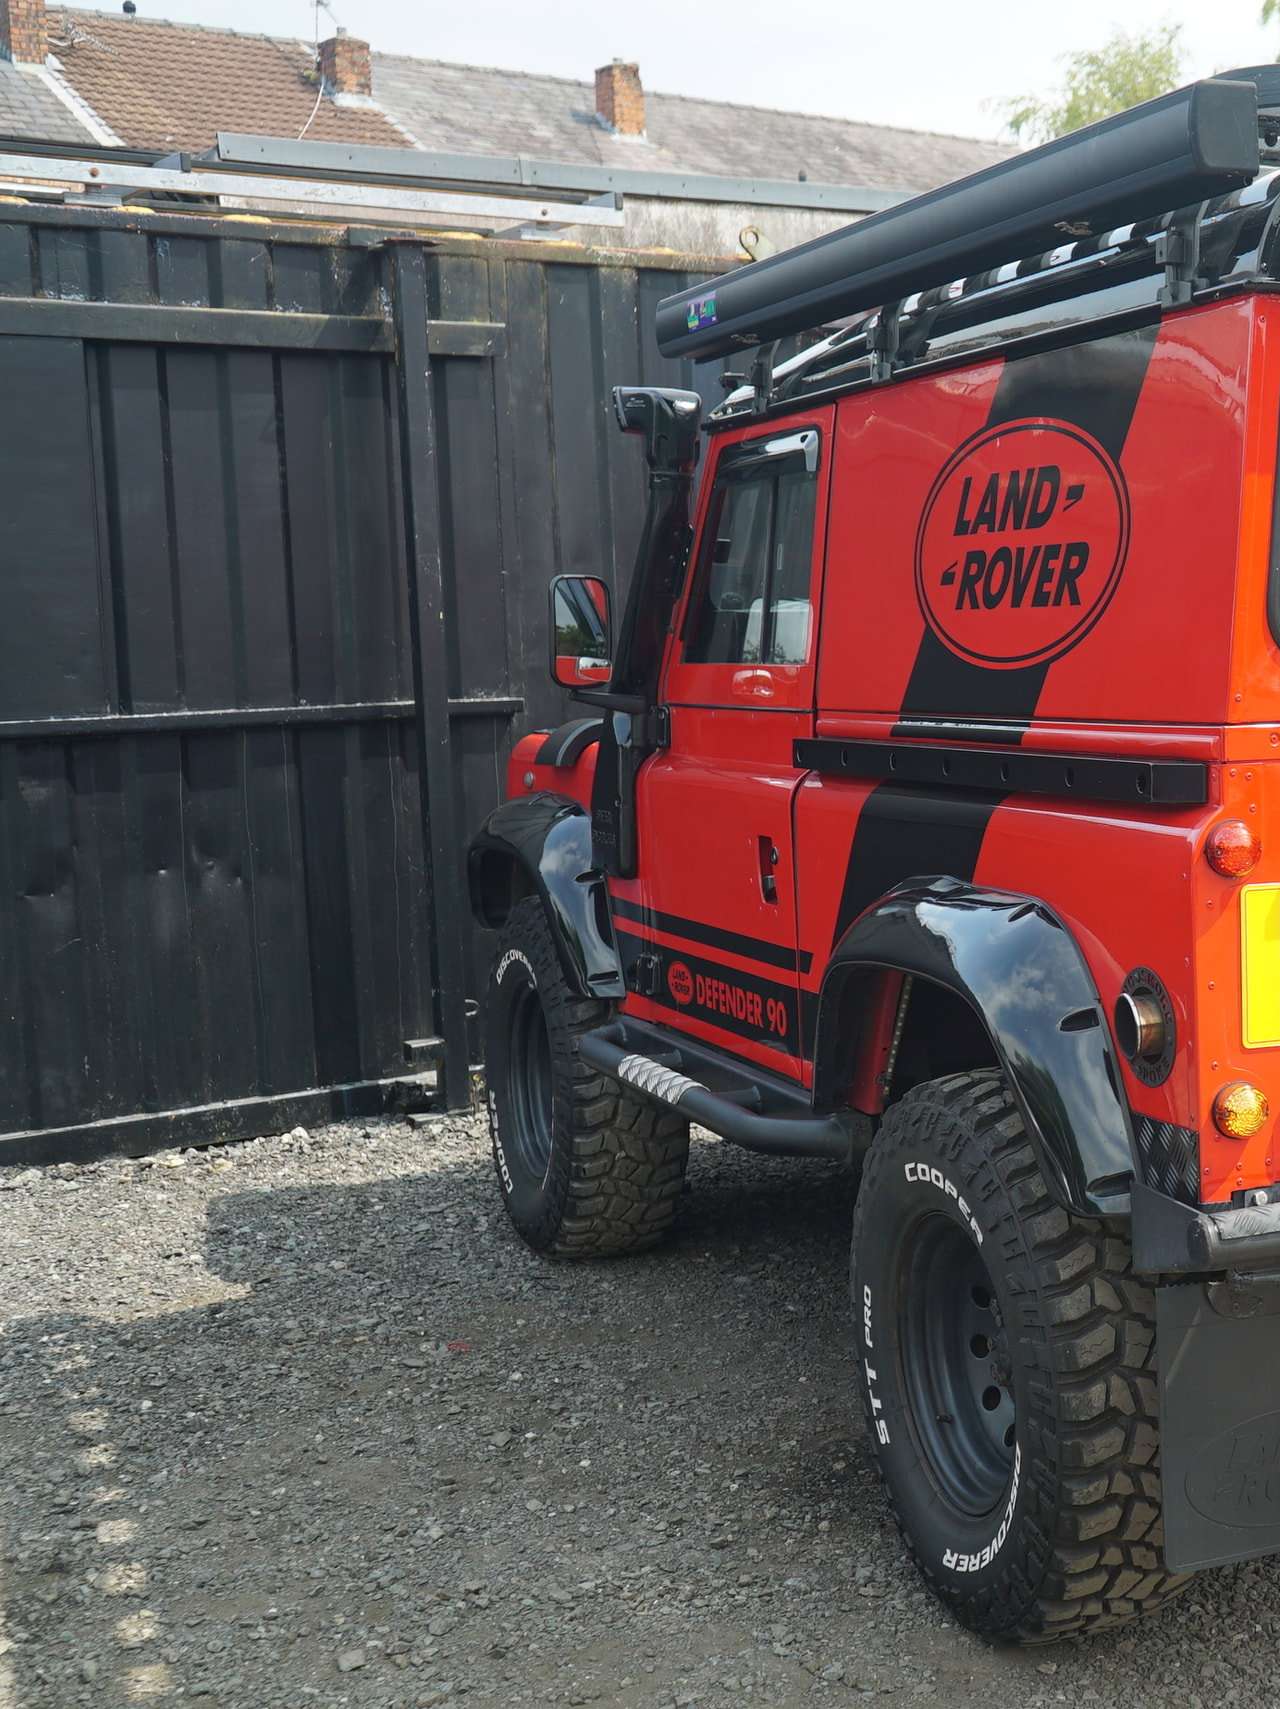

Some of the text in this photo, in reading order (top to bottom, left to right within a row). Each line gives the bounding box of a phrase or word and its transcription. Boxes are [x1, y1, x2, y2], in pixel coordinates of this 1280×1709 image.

[695, 974, 788, 1036] DEFENDER 90
[904, 1161, 984, 1248] COOPER
[863, 1285, 890, 1445] STT PRO
[942, 1440, 1022, 1573] DISCOVERER
